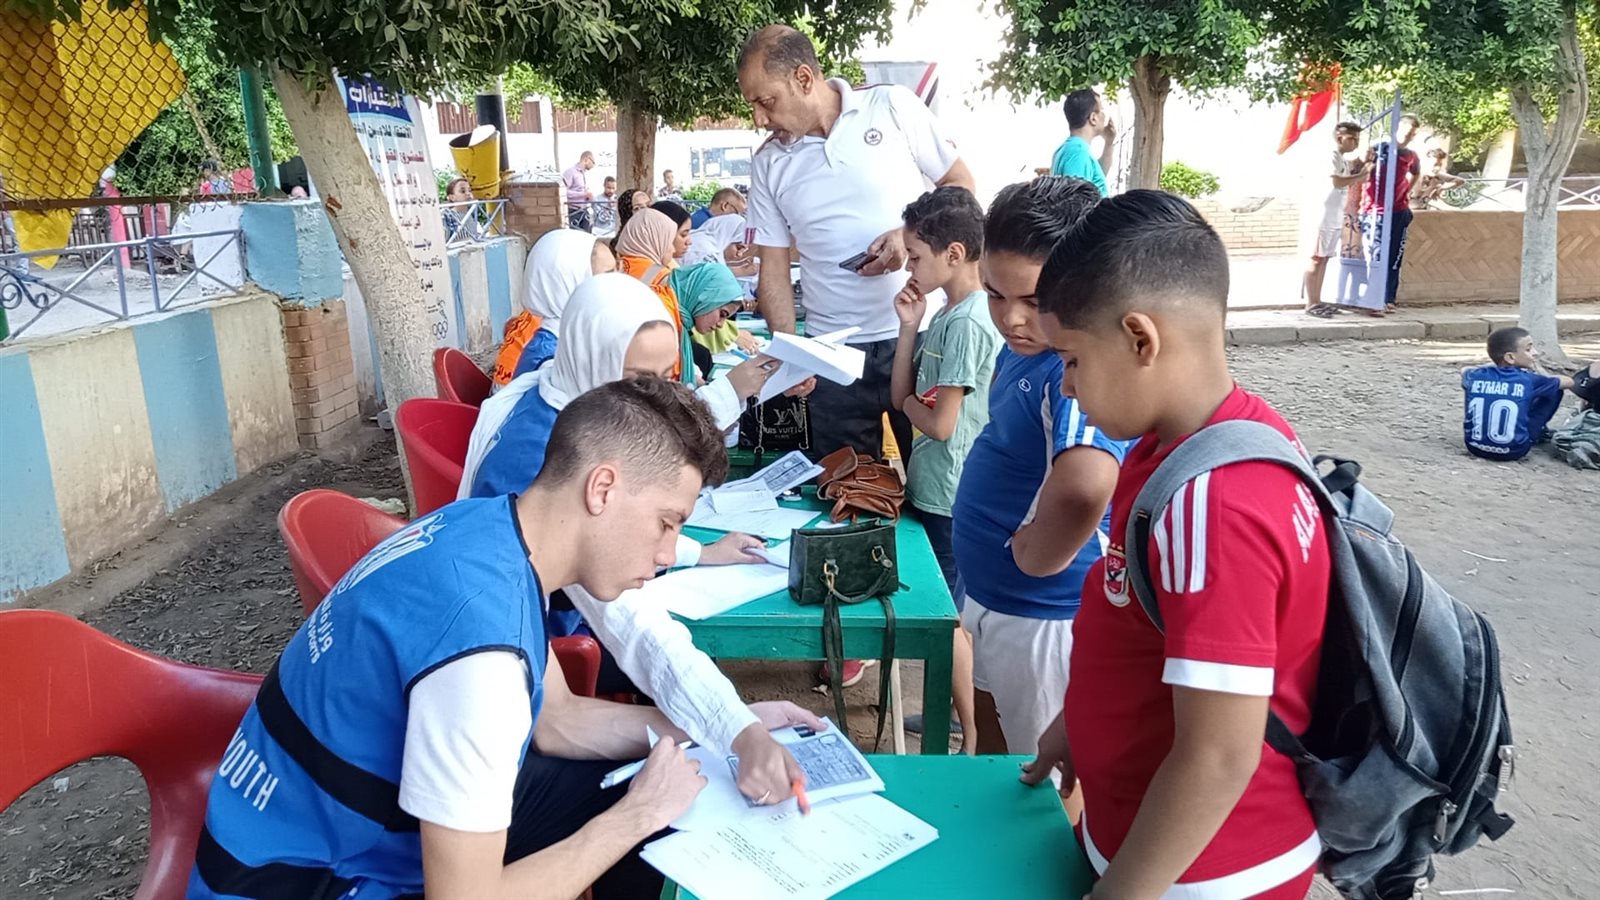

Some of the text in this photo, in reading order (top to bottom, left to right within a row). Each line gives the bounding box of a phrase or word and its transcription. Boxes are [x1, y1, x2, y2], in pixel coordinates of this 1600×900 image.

[1471, 380, 1525, 397] NEYMAR JR
[1468, 397, 1519, 444] 10
[218, 727, 280, 812] YOUTH
